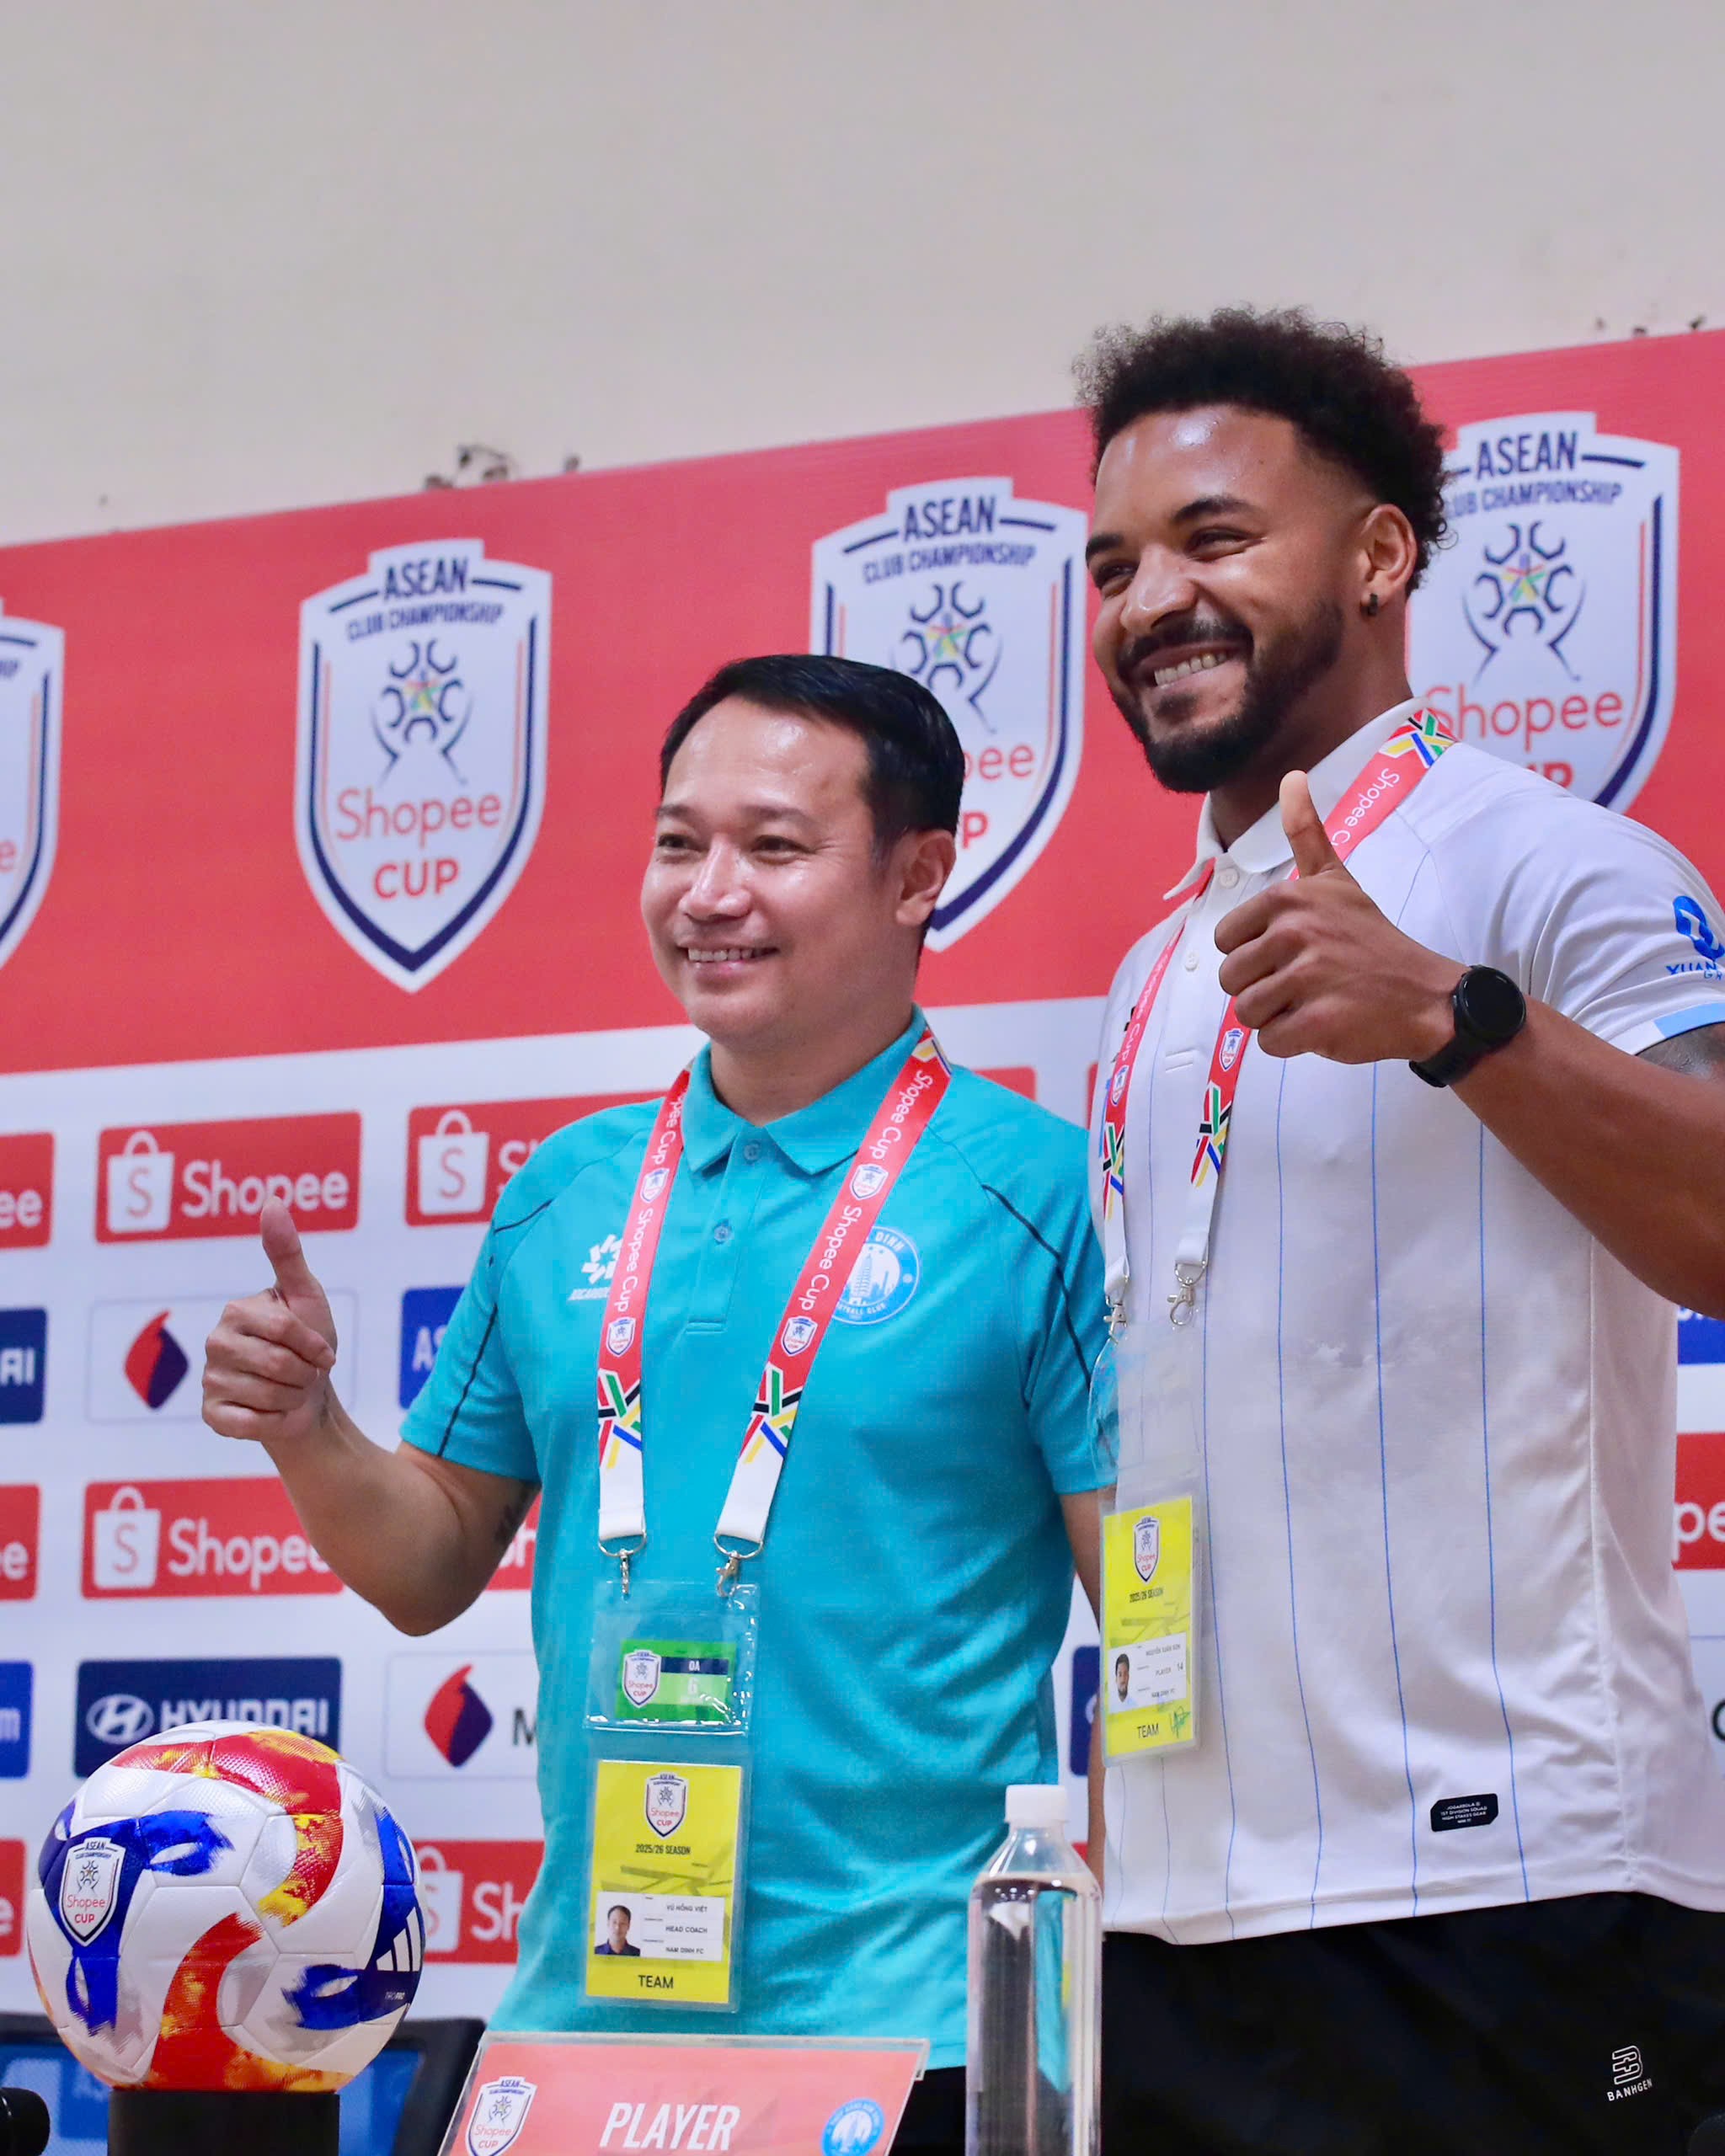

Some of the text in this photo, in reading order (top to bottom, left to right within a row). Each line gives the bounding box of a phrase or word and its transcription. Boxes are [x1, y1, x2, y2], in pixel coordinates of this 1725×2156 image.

[1477, 430, 1578, 480] ASEAN
[905, 493, 996, 542] ASEAN
[1444, 480, 1622, 520] LUB CHAMPIONSHIP
[383, 557, 468, 602] ASEAN
[863, 541, 1036, 585] CLUB CHAMPIONSHIP
[348, 602, 505, 641] CLUB CHAMPIONSHIP
[1344, 768, 1400, 827] Shopee
[338, 787, 501, 849] Shopee
[373, 857, 459, 899] CUP
[890, 1070, 934, 1126] Shopee
[651, 1131, 676, 1165] Cup
[868, 1126, 902, 1161] Cup
[181, 1160, 350, 1219] Shopee
[626, 1208, 654, 1273] Shopee
[819, 1204, 862, 1271] Shopee
[614, 1276, 638, 1312] Cup
[798, 1273, 830, 1311] Cup
[1137, 1723, 1159, 1738] TEAM
[635, 1844, 692, 1855] 2025/26 SEASON
[67, 1894, 105, 1912] Shopee
[74, 1913, 94, 1924] CUP
[638, 1974, 674, 1989] TEAM
[1607, 2078, 1653, 2101] BANHGEN
[474, 2123, 513, 2138] Shopee
[478, 2140, 499, 2148] CUP
[599, 2102, 740, 2151] PLAYER
